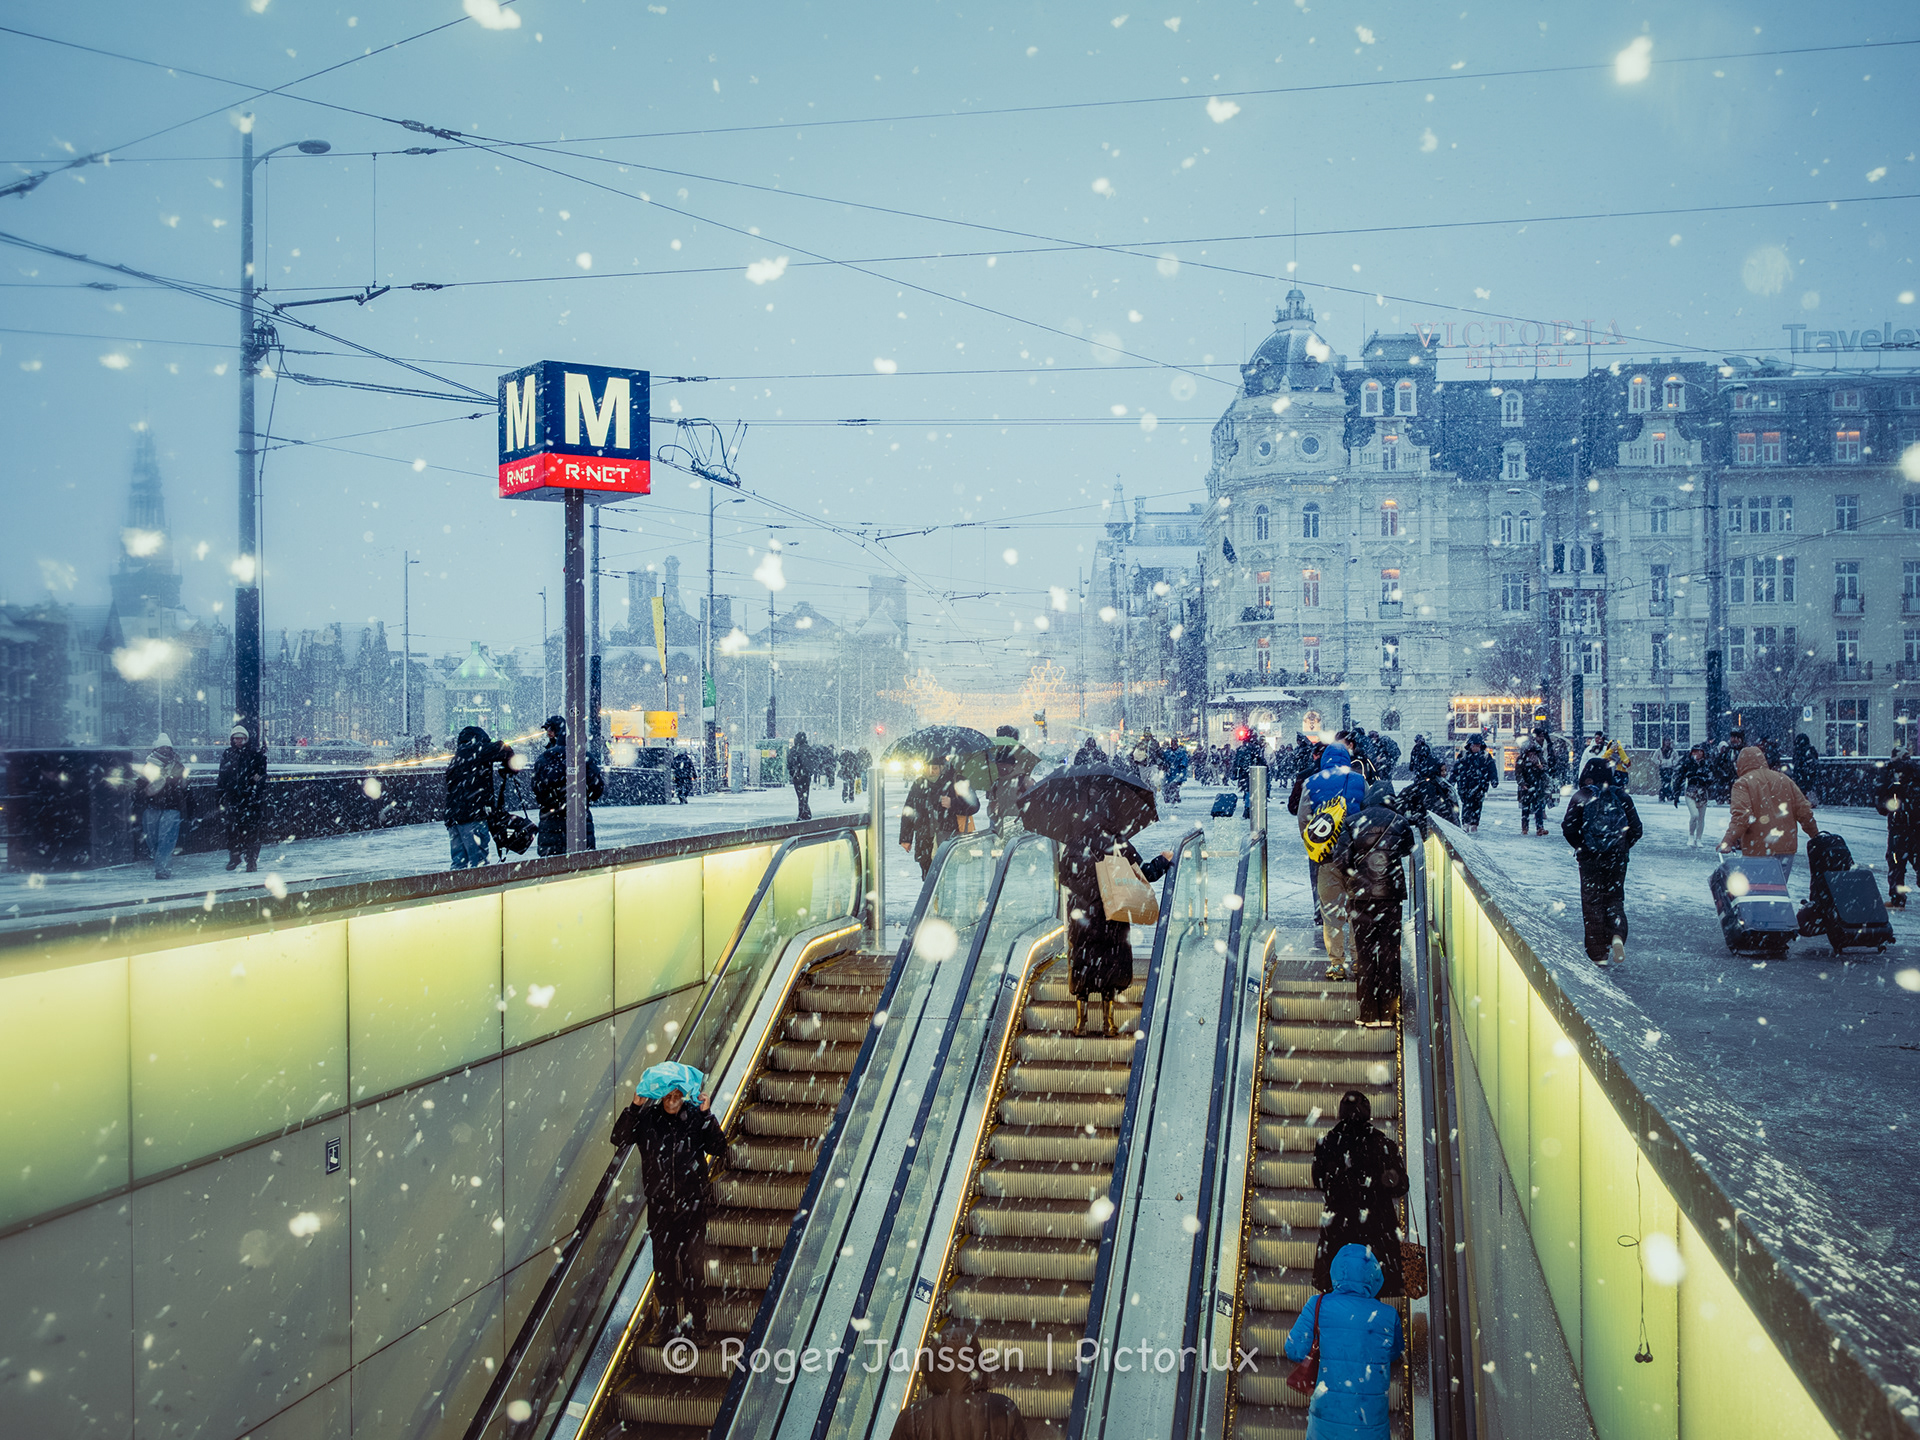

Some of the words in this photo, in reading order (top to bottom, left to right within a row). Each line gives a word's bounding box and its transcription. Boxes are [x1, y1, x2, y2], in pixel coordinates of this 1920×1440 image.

[1411, 318, 1627, 348] VICTORIA
[1782, 321, 1920, 352] Travele
[1465, 348, 1572, 369] HOTEL
[507, 373, 536, 453] M
[565, 372, 630, 449] M
